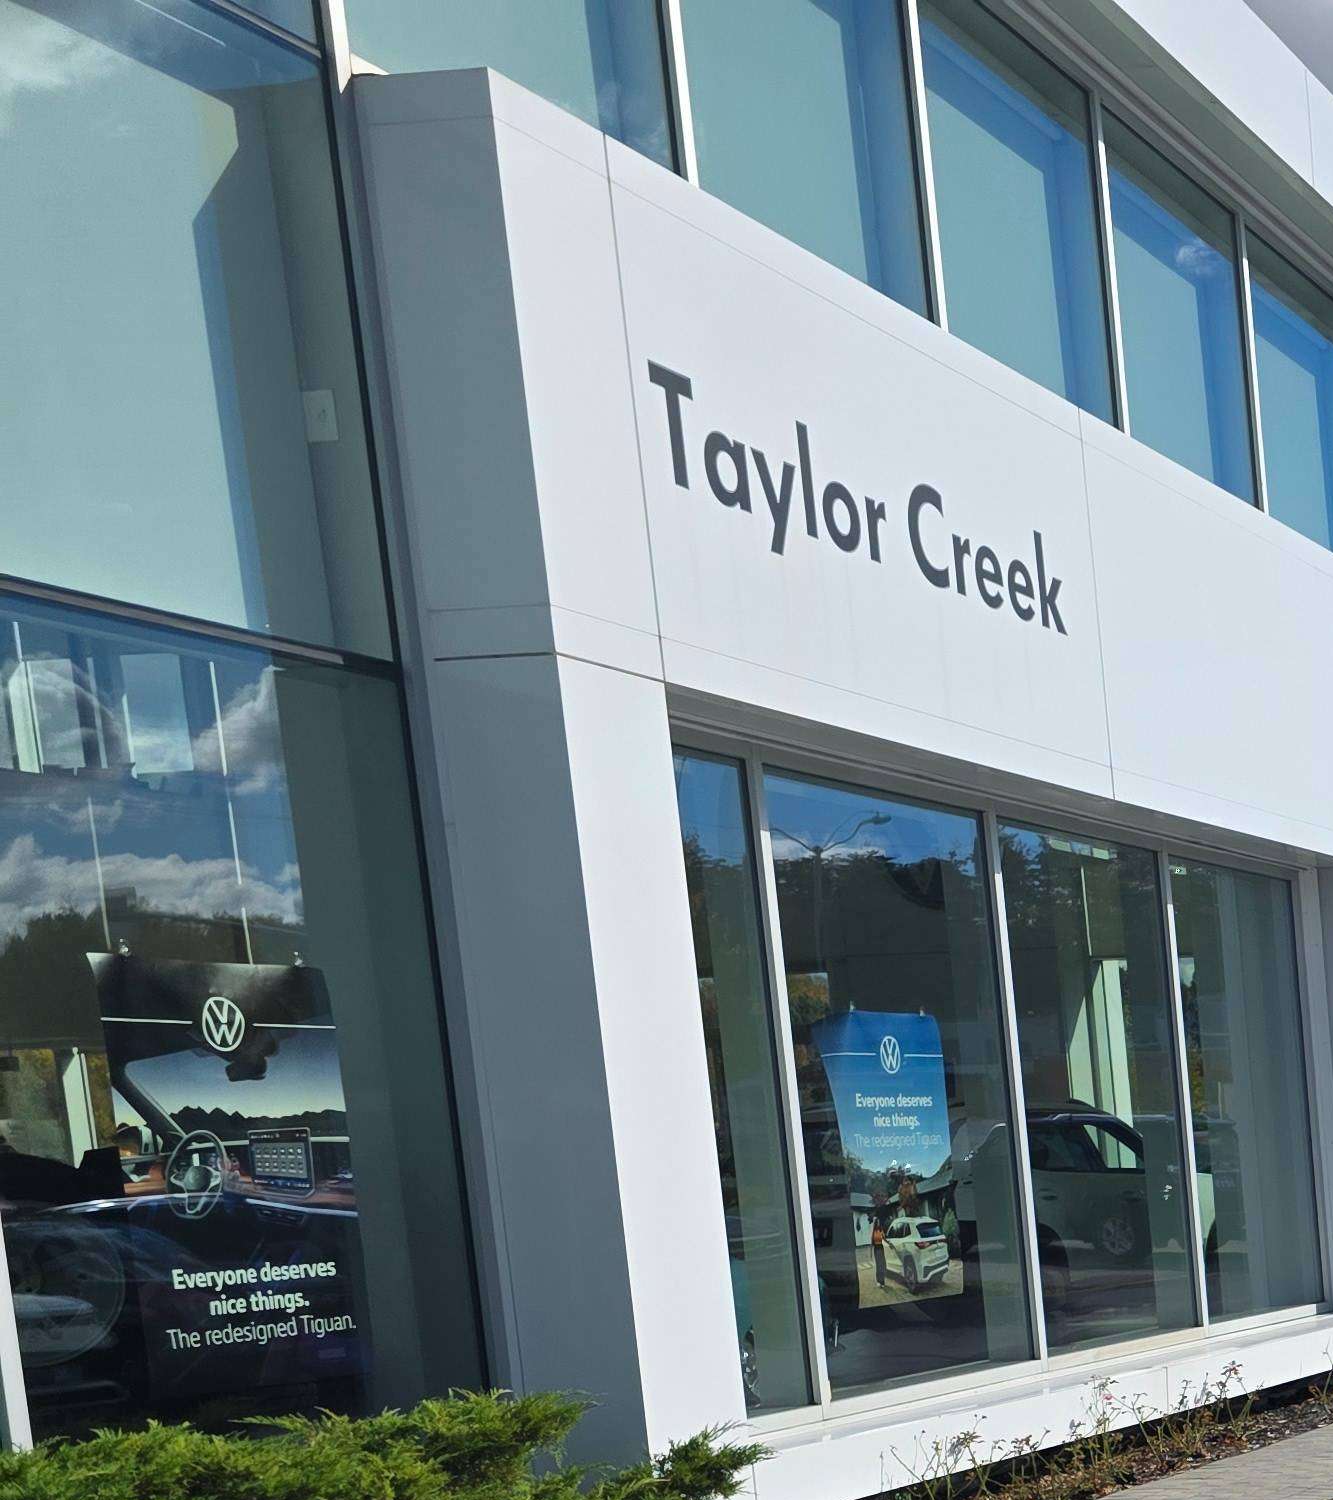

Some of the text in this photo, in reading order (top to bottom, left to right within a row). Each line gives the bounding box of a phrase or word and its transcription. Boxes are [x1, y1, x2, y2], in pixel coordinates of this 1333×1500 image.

[647, 358, 1069, 636] Taylor Creek
[855, 1093, 933, 1111] Everyone deserves
[873, 1113, 921, 1130] nice things.
[854, 1133, 871, 1148] The
[871, 1133, 916, 1150] redesigned
[171, 1261, 337, 1291] Everyone deserves
[209, 1289, 310, 1316] nice things.
[166, 1314, 357, 1350] The redesigned Tiguan.
